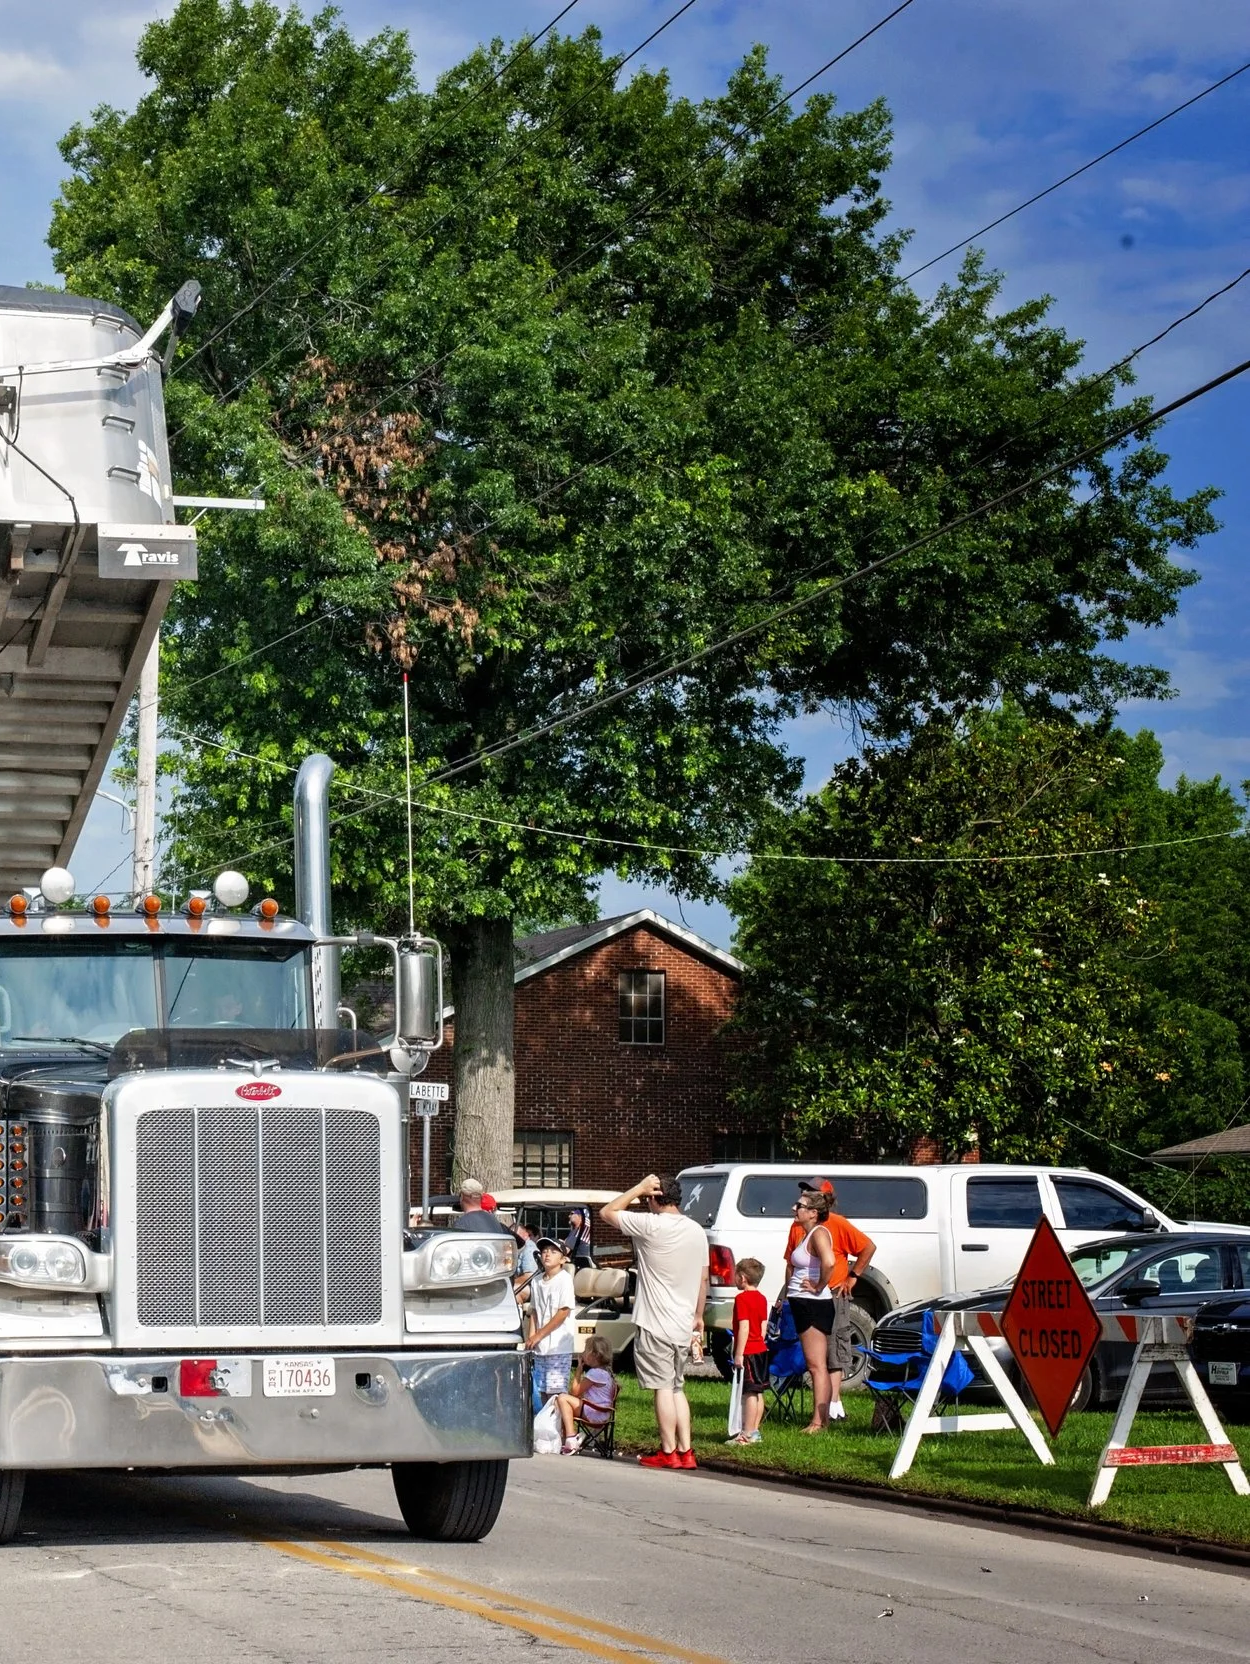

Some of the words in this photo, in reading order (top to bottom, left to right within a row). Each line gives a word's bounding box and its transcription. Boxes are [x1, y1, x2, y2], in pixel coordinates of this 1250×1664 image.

[116, 543, 180, 566] Travis
[410, 1084, 445, 1098] LABETTE
[1021, 1280, 1072, 1308] STREET
[1018, 1328, 1082, 1359] CLOSED
[279, 1368, 331, 1388] 170436
